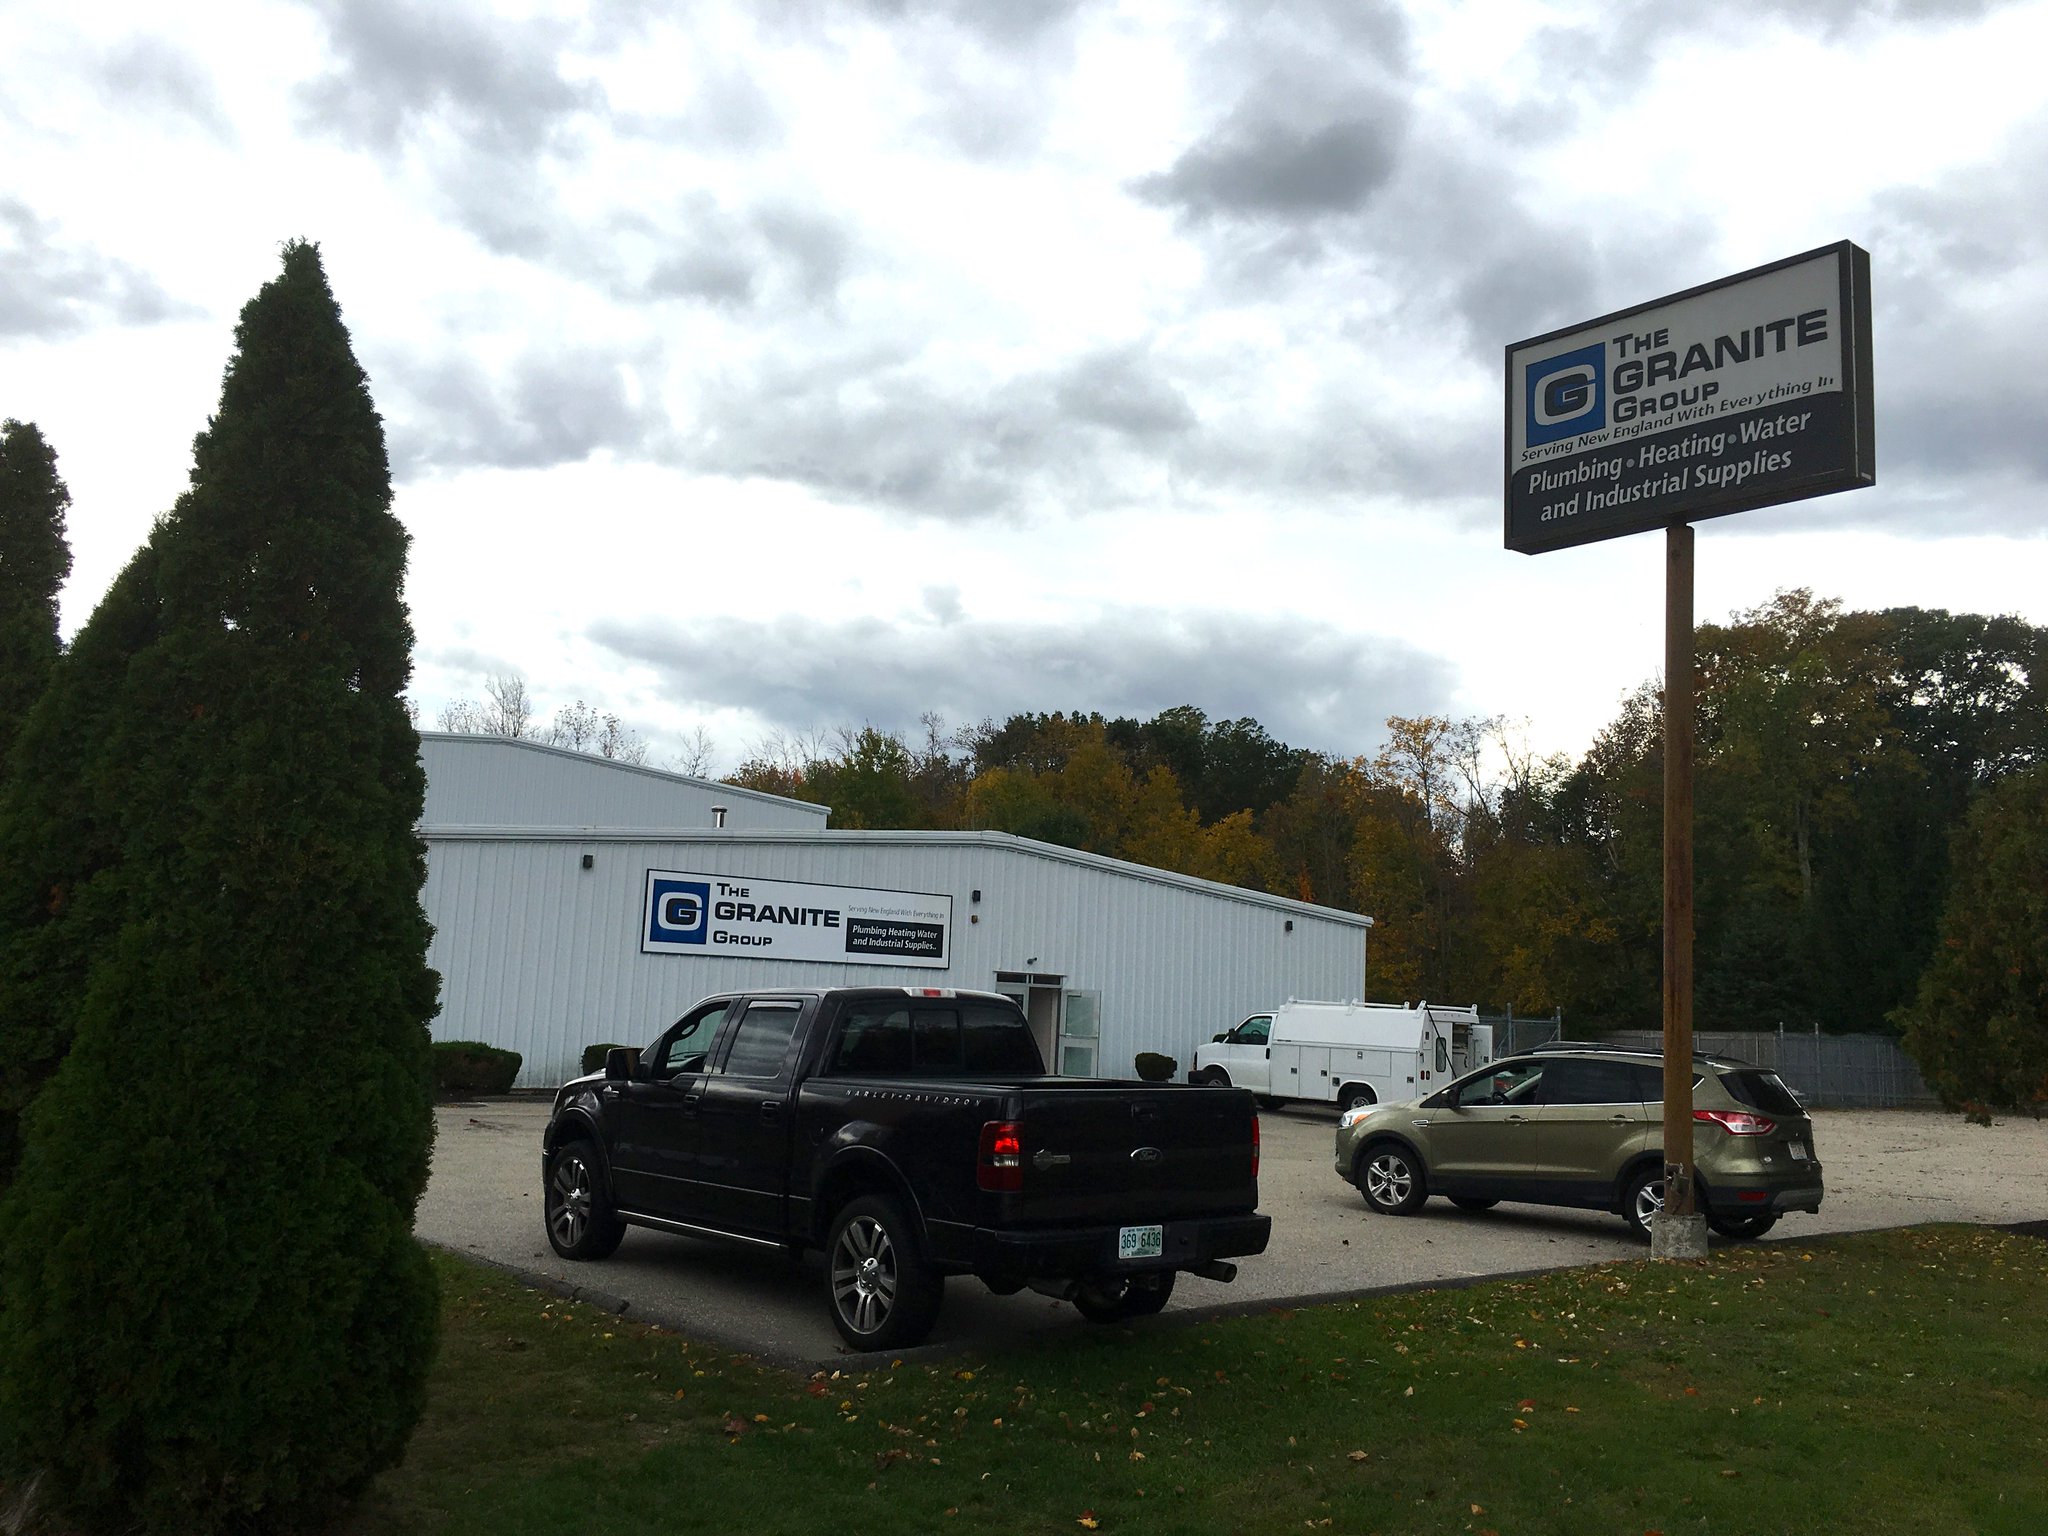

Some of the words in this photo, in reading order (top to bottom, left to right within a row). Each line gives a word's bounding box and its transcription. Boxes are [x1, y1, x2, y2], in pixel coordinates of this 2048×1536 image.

[1613, 327, 1669, 358] THE
[1613, 308, 1828, 395] GRANITE
[1613, 382, 1720, 424] GROUP
[1521, 440, 1574, 462] Serving
[1578, 431, 1610, 448] New
[1613, 413, 1674, 439] England
[1677, 403, 1715, 422] With
[1720, 380, 1813, 412] Everything
[1528, 456, 1623, 494] Plumbing
[1638, 431, 1726, 468] Heating
[1740, 411, 1812, 444] Water
[1540, 497, 1579, 521] and
[1585, 468, 1690, 512] Industrial
[1694, 450, 1793, 488] Supplies
[716, 882, 750, 898] THE
[714, 901, 841, 928] GRANITE
[848, 904, 867, 914] Serving
[868, 906, 879, 914] New
[880, 907, 900, 917] England
[912, 910, 939, 919] Everything
[712, 930, 773, 947] GROUP
[852, 924, 887, 938] Plumbing
[888, 927, 916, 940] Heating
[917, 929, 938, 939] Water
[852, 936, 868, 946] and
[868, 937, 904, 948] Industrial
[1121, 1233, 1137, 1249] 369
[1141, 1231, 1161, 1248] 6436
